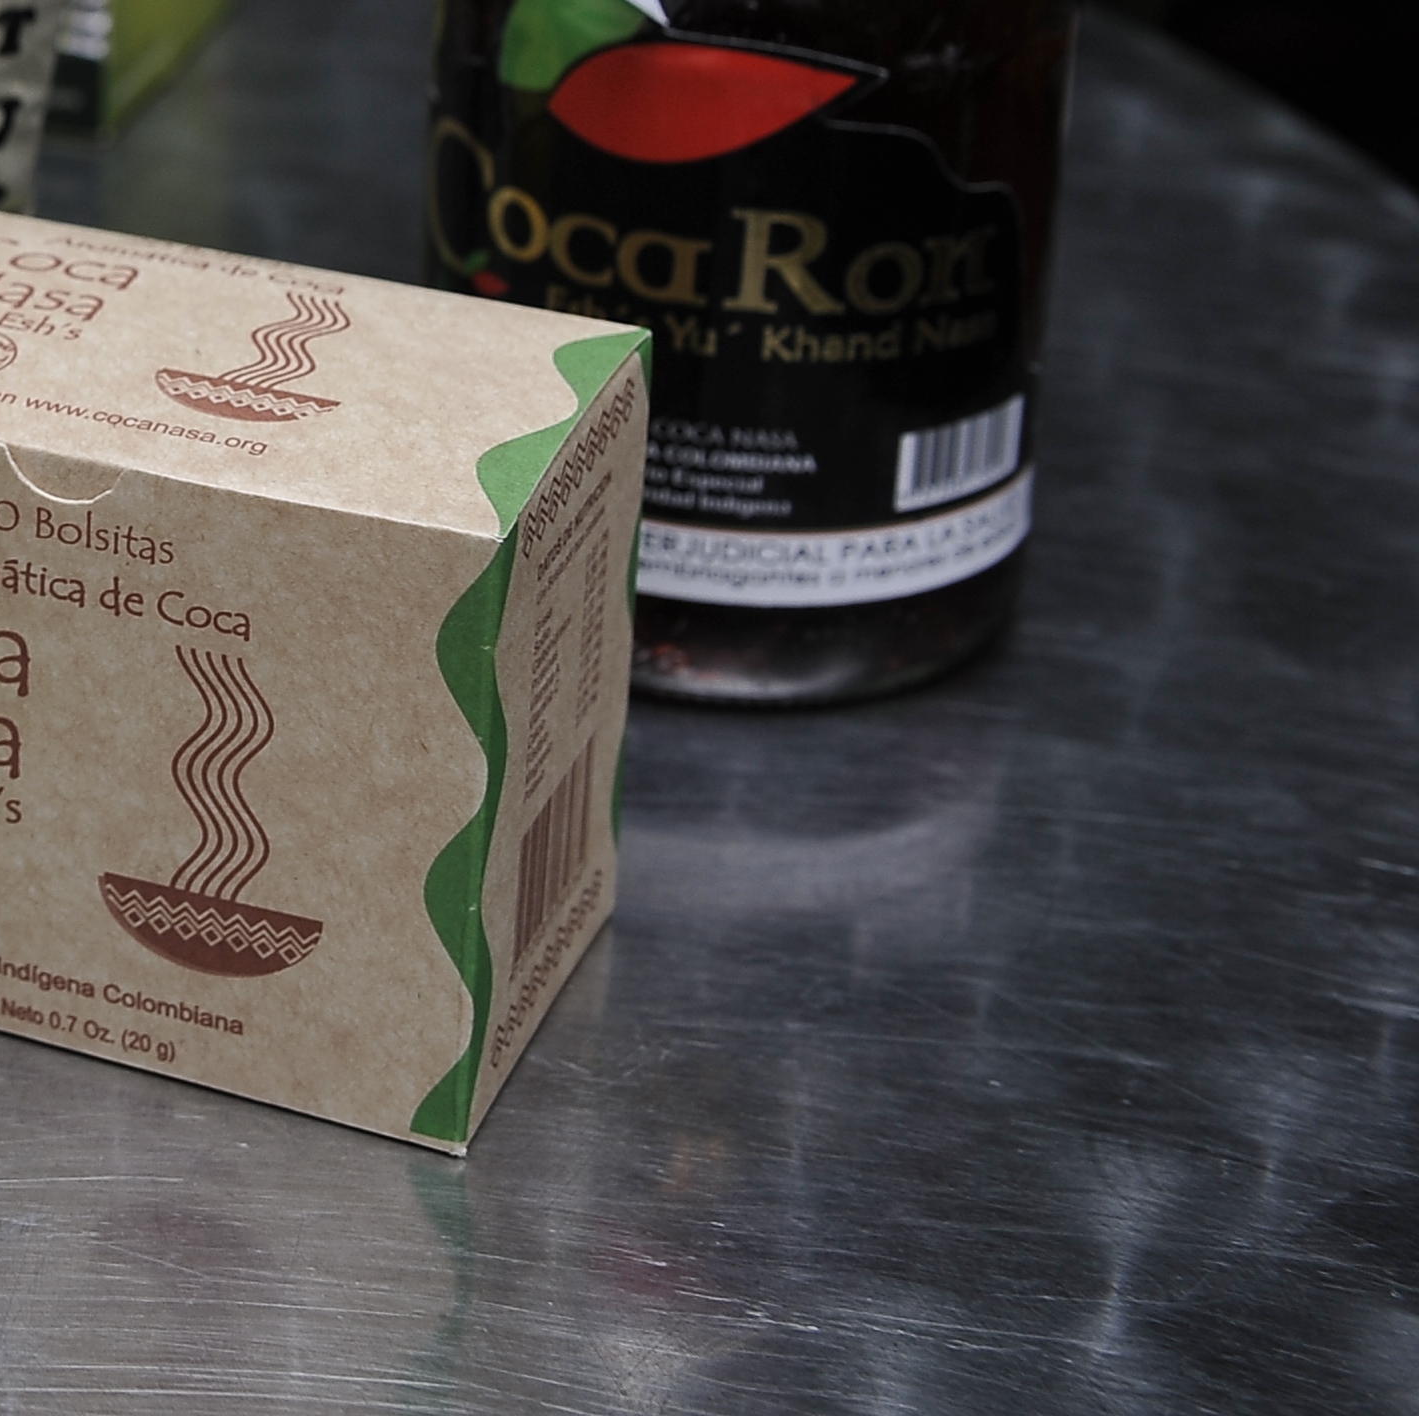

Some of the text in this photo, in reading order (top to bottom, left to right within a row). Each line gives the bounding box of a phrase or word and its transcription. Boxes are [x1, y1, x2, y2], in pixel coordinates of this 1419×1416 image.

[762, 324, 900, 363] Khand
[25, 396, 269, 457] www.cocanasa.org
[35, 507, 175, 565] Bolsitas
[642, 530, 824, 563] ERJUDICIAL
[842, 534, 916, 560] PARA
[99, 576, 144, 616] de
[156, 591, 251, 641] Coca
[2, 999, 43, 1026] Neto
[49, 1012, 77, 1033] 0.7
[84, 1021, 114, 1044] Oz.
[122, 1031, 151, 1054] (20
[157, 1039, 176, 1064] g)
[103, 985, 244, 1036] Colombiana
